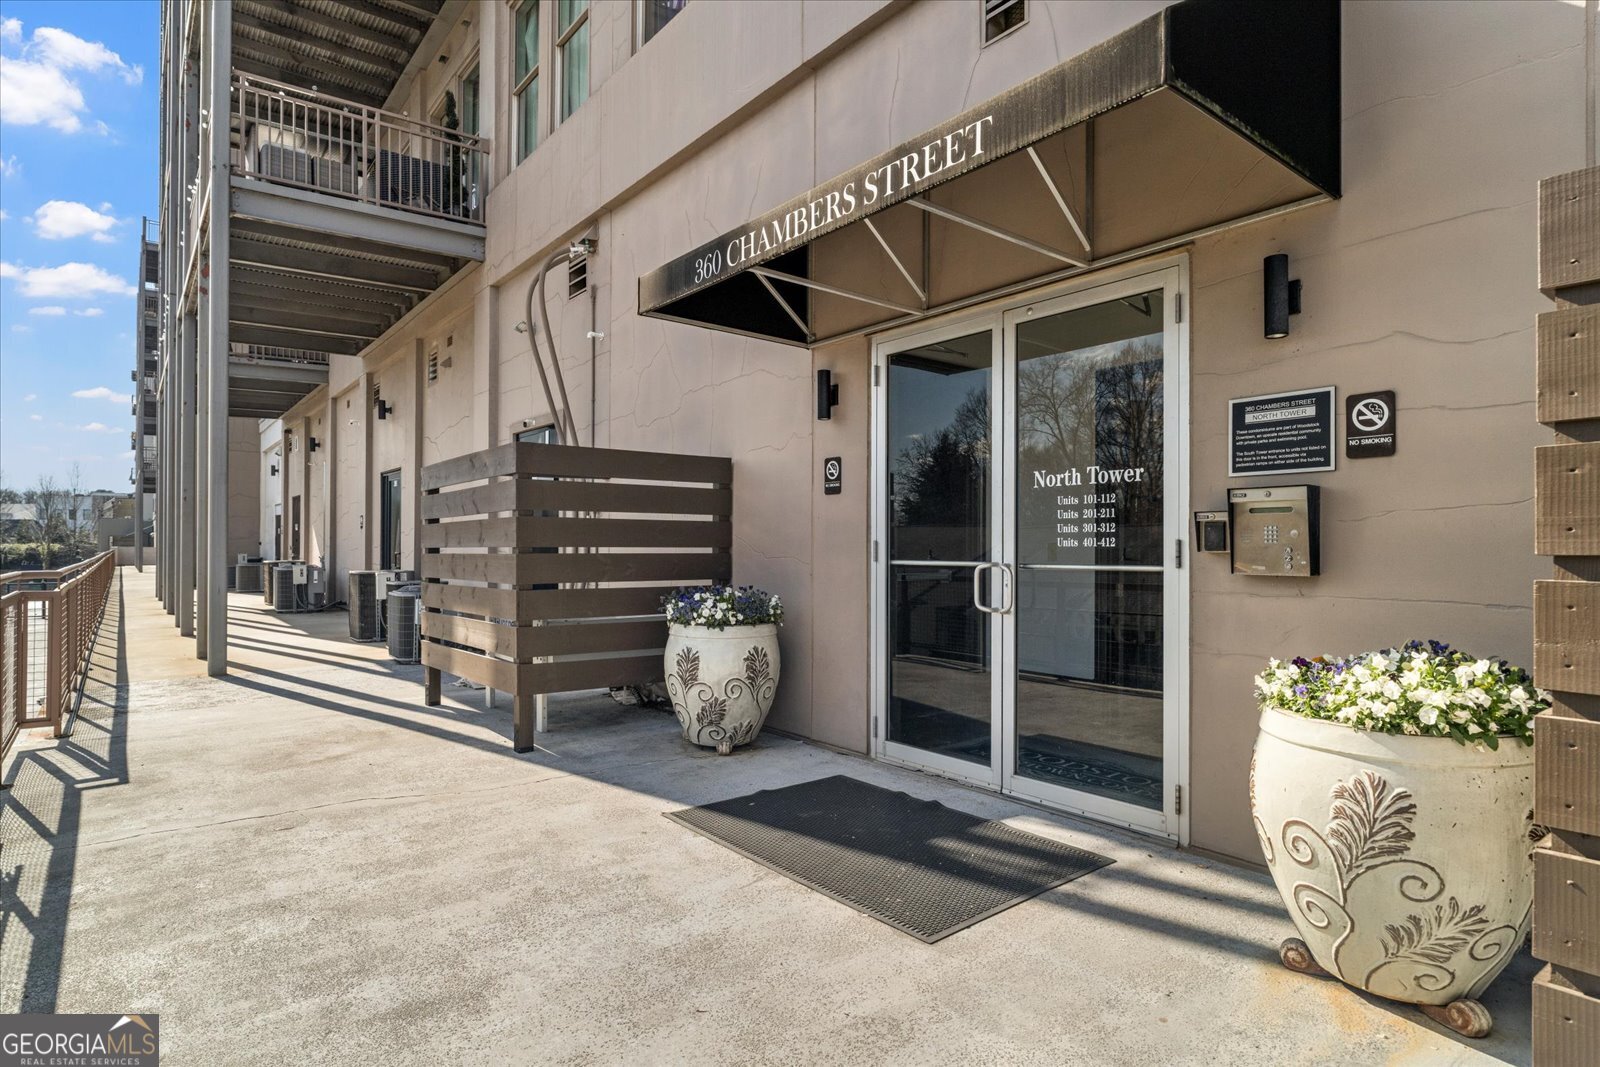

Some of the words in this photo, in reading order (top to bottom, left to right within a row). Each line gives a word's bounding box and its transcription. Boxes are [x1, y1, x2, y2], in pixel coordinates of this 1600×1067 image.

[694, 249, 722, 283] 360
[726, 182, 856, 267] CHAMBERS
[863, 115, 993, 206] STREET
[1256, 400, 1290, 411] CHAMBERS
[1290, 398, 1316, 406] STREET
[1252, 412, 1278, 420] NORTH
[1280, 408, 1307, 418] TOWER
[1361, 436, 1392, 445] SMOKING
[1033, 468, 1082, 488] North
[1086, 466, 1144, 484] Tower
[1057, 495, 1078, 506] Units
[1083, 492, 1116, 504] 101-112
[1057, 509, 1078, 519] Units
[1082, 508, 1116, 518] 201-211
[1057, 524, 1078, 533] Units
[1082, 523, 1116, 533] 301-312
[1057, 537, 1078, 547] Units
[1082, 537, 1116, 548] 401-412
